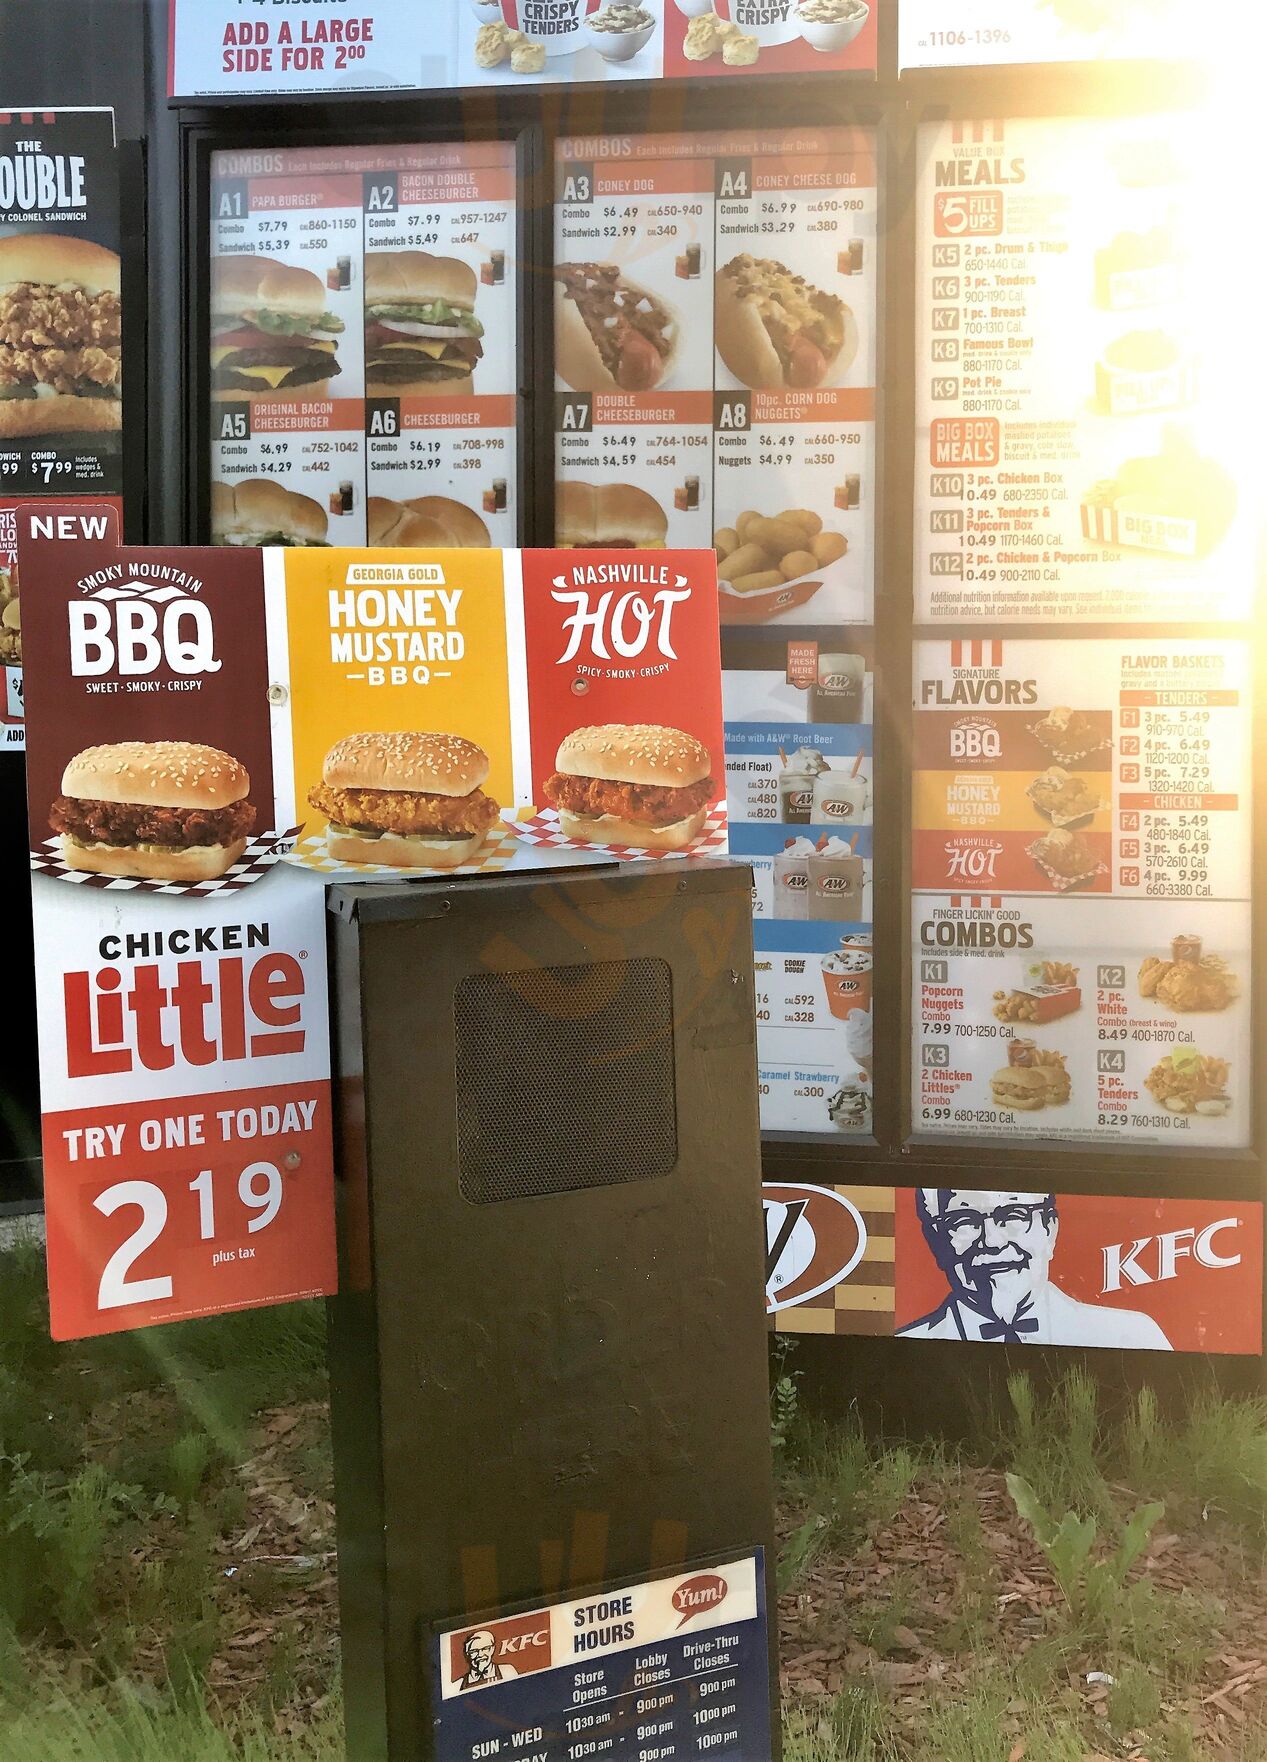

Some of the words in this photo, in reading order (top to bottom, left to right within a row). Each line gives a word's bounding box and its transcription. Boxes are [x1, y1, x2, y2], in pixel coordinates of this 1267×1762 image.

[525, 1, 577, 20] CRISPY
[736, 5, 789, 24] CRISPY
[222, 22, 269, 46] ADD
[277, 21, 293, 44] A
[301, 18, 374, 43] LARGE
[523, 17, 579, 35] TENDERS
[929, 29, 1011, 47] 1106-1396
[222, 48, 272, 72] SIDE
[281, 47, 324, 71] FOR
[15, 141, 42, 152] THE
[562, 138, 632, 158] COMBOS
[935, 157, 1026, 187] MEALS
[368, 185, 394, 210] A2
[402, 175, 434, 187] BACON
[437, 173, 476, 185] DOUBLE
[563, 176, 590, 201] A3
[597, 180, 631, 192] CONEY
[634, 179, 654, 191] DOG
[720, 171, 747, 196] A4
[756, 175, 790, 187] CONEY
[793, 173, 833, 186] CHEESE
[835, 173, 857, 185] DOG
[402, 187, 479, 201] CHEESEBURGER
[219, 192, 241, 216] A1
[252, 196, 276, 207] PAPA
[562, 208, 590, 218] Combo
[603, 206, 639, 218] $6.49
[969, 198, 998, 214] FILL
[8, 213, 43, 222] COLONEL
[45, 212, 87, 221] SANDWICH
[408, 214, 441, 226] $7.99
[969, 214, 996, 228] UPS
[408, 233, 438, 245] $5.49
[562, 228, 600, 238] Sandwich
[603, 226, 636, 237] $2.99
[934, 279, 958, 297] K6
[995, 274, 1036, 286] Tenders
[934, 342, 957, 360] K8
[963, 338, 1004, 350] Famous
[1007, 337, 1034, 348] Bowl
[934, 381, 957, 398] K9
[963, 377, 981, 388] Pot
[985, 376, 1002, 388] Pie
[562, 404, 588, 429] A7
[596, 395, 636, 407] DOUBLE
[596, 409, 676, 421] CHEESEBURGER
[719, 403, 747, 428] A8
[785, 393, 813, 405] CORN
[816, 392, 837, 404] DOG
[221, 413, 246, 438] A5
[254, 404, 299, 416] ORIGINAL
[301, 402, 333, 414] BACON
[254, 417, 329, 429] CHEESEBURGER
[370, 409, 396, 434] A6
[404, 413, 480, 426] CHEESEBURGER
[936, 423, 961, 441] BIG
[965, 422, 994, 440] BOX
[260, 443, 289, 454] $6.99
[602, 436, 637, 447] $6.49
[31, 452, 57, 460] COMBO
[602, 455, 637, 466] $4.59
[936, 441, 995, 463] MEALS
[260, 462, 292, 473] $4.29
[718, 456, 751, 467] Nuggets
[932, 476, 962, 494] K10
[997, 472, 1040, 484] Chicken
[30, 515, 108, 540] NEW
[932, 512, 959, 530] K11
[966, 520, 1010, 533] Popcorn
[931, 555, 961, 573] K12
[996, 552, 1039, 564] Chicken
[1053, 551, 1098, 565] Popcorn
[77, 564, 123, 594] SMOKY
[128, 562, 203, 594] MOUNTAIN
[353, 568, 404, 580] GEORGIA
[408, 568, 438, 580] GOLD
[572, 564, 669, 585] NASHVILLE
[328, 589, 464, 628] HONEY
[550, 588, 692, 664] HOT
[68, 599, 223, 677] BBQ
[330, 631, 465, 663] MUSTARD
[790, 649, 814, 657] MADE
[576, 664, 602, 677] SPICY
[606, 669, 636, 679] SMOKY
[640, 662, 670, 676] CRISPY
[789, 658, 816, 666] FRESH
[791, 666, 814, 674] HERE
[952, 668, 1000, 679] SIGNATURE
[86, 682, 119, 694] SWEET
[126, 681, 161, 692] SMOKY
[167, 680, 202, 691] CRISPY
[921, 679, 1038, 705] FLAVORS
[1155, 691, 1208, 705] TENDERS
[793, 734, 812, 744] Root
[814, 735, 834, 744] Beer
[950, 728, 1003, 758] BBQ
[946, 785, 1000, 801] HONEY
[946, 803, 1000, 815] MUSTARD
[1154, 795, 1202, 809] CHICKEN
[1121, 815, 1138, 829] F4
[1178, 815, 1209, 827] 5.49
[953, 838, 995, 848] NASHVILLE
[944, 848, 1004, 878] HOT
[933, 908, 963, 920] FINGER
[996, 910, 1021, 920] GOOD
[99, 922, 270, 961] CHICKEN
[920, 921, 1034, 949] COMBOS
[784, 959, 806, 967] COOKIE
[924, 963, 943, 980] K1
[1099, 969, 1123, 986] K2
[921, 984, 964, 997] Popcorn
[921, 998, 964, 1012] Nuggets
[1097, 1003, 1128, 1015] White
[922, 1022, 951, 1034] 7.99
[954, 1024, 997, 1037] 700-1250
[1097, 1029, 1128, 1040] 8.49
[1131, 1030, 1176, 1042] 400-1870
[924, 1047, 947, 1064] K3
[1099, 1053, 1124, 1070] K4
[794, 1071, 840, 1084] Strawberry
[932, 1069, 973, 1082] Chicken
[1097, 1088, 1139, 1100] Tenders
[954, 1109, 997, 1123] 680-1230
[1131, 1115, 1171, 1128] 760-1310
[62, 1123, 127, 1161] TRY
[139, 1113, 206, 1152] ONE
[216, 1099, 318, 1142] TODAY
[212, 1248, 236, 1266] plus
[238, 1247, 256, 1260] tax
[1099, 1217, 1242, 1294] KFC
[675, 1580, 726, 1609] Yum!
[573, 1595, 633, 1628] STORE
[498, 1628, 549, 1657] KFC
[573, 1620, 635, 1654] HOURS
[574, 1669, 605, 1687] Store
[635, 1652, 668, 1672] Lobby
[683, 1633, 740, 1659] Drive-Thru
[572, 1684, 608, 1705] Opens
[633, 1667, 671, 1688] Closes
[693, 1653, 730, 1672] Closes
[471, 1737, 501, 1761] SUN
[511, 1726, 544, 1749] WED
